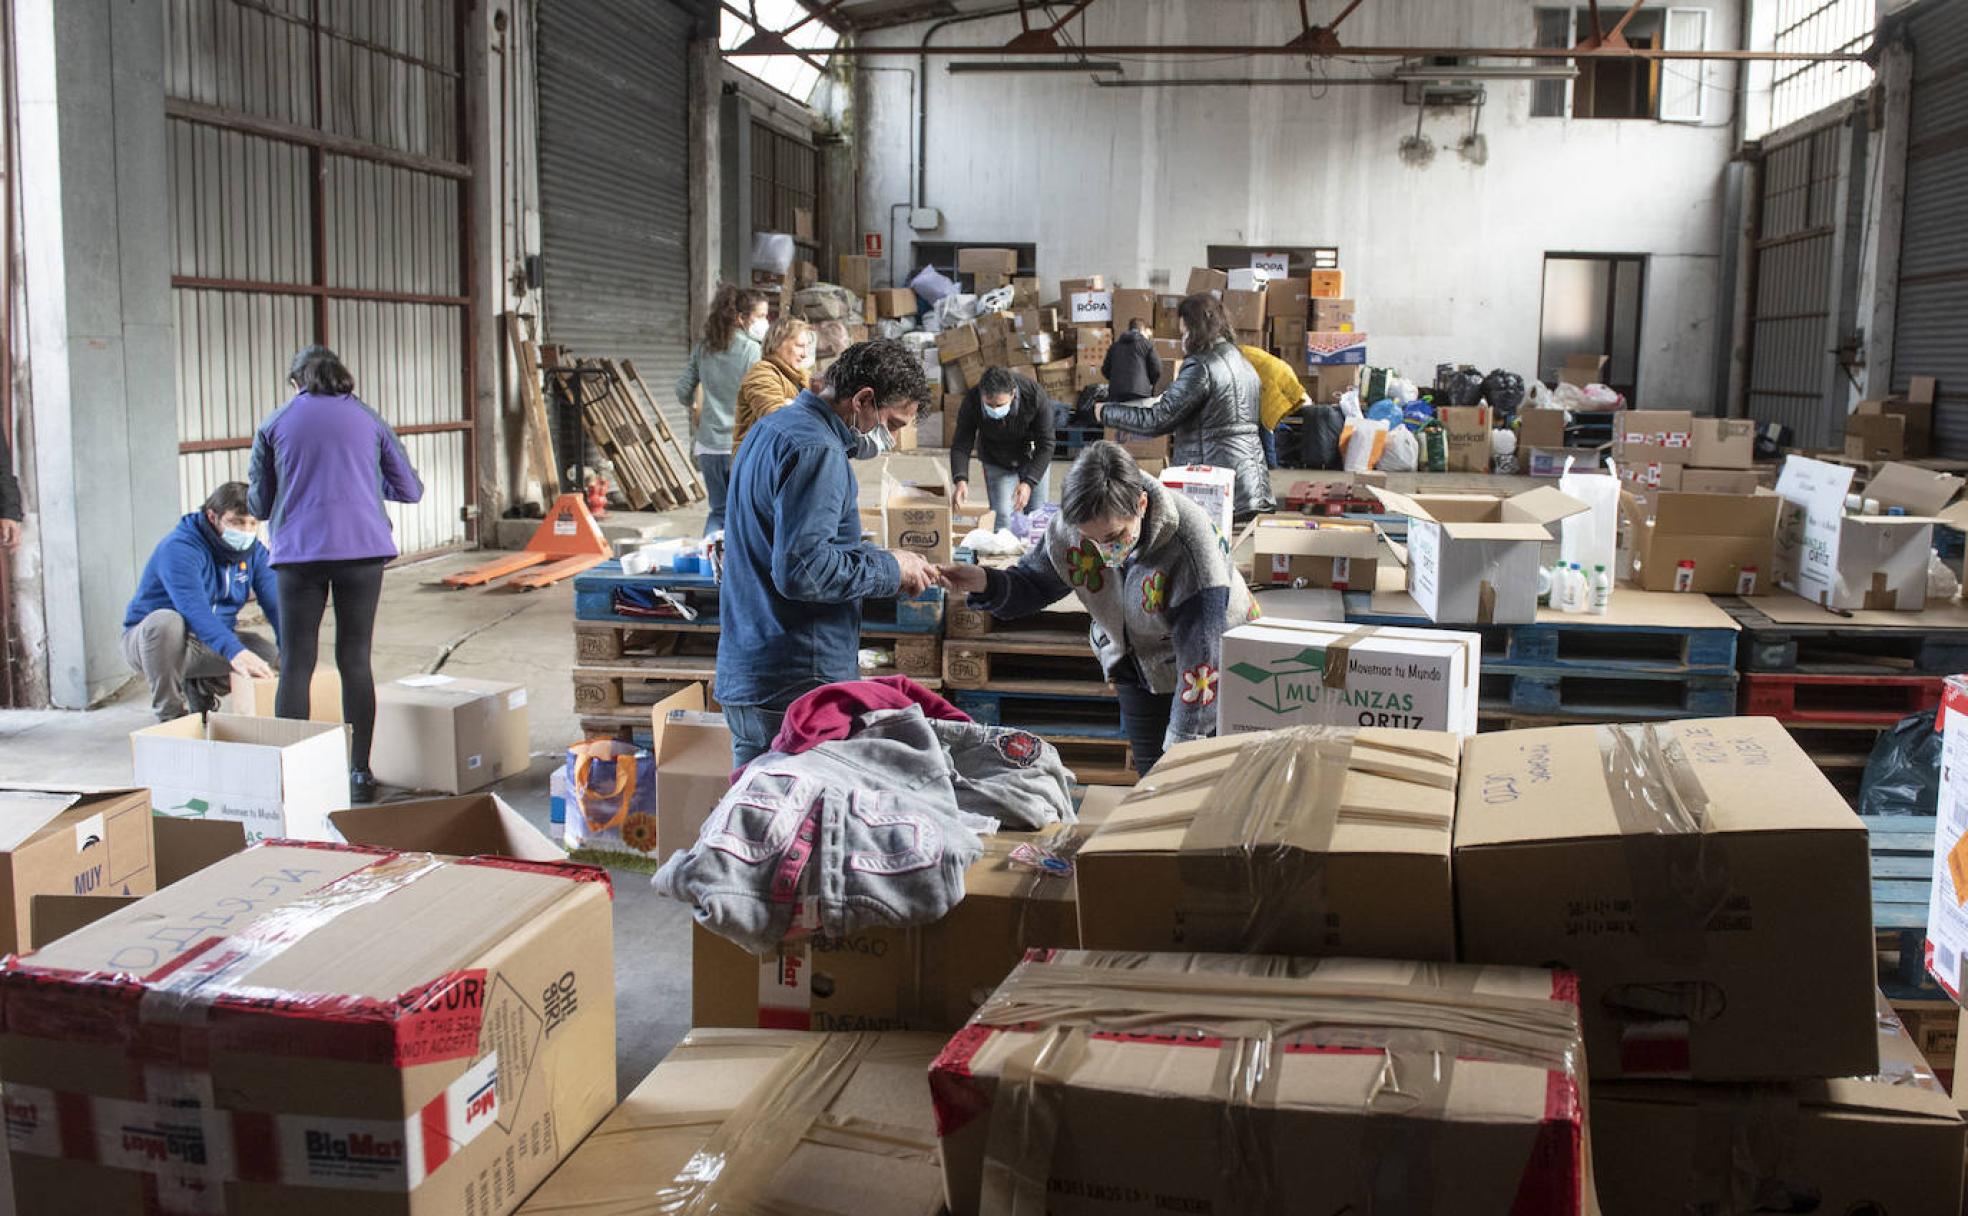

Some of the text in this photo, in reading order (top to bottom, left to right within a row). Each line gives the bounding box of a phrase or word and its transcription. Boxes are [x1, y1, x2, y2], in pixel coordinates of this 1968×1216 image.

[1255, 262, 1284, 272] ROPA
[1076, 302, 1108, 312] ROPA
[1350, 659, 1441, 681] Movemos tu Mundo
[1286, 683, 1414, 711] MUANZAS
[1358, 711, 1424, 729] ORTIZ
[75, 865, 102, 895] MUY
[401, 1039, 428, 1057] NOT
[431, 1032, 475, 1054] ACCEPT
[466, 1088, 495, 1124] Mat
[305, 1130, 403, 1159] BigMat
